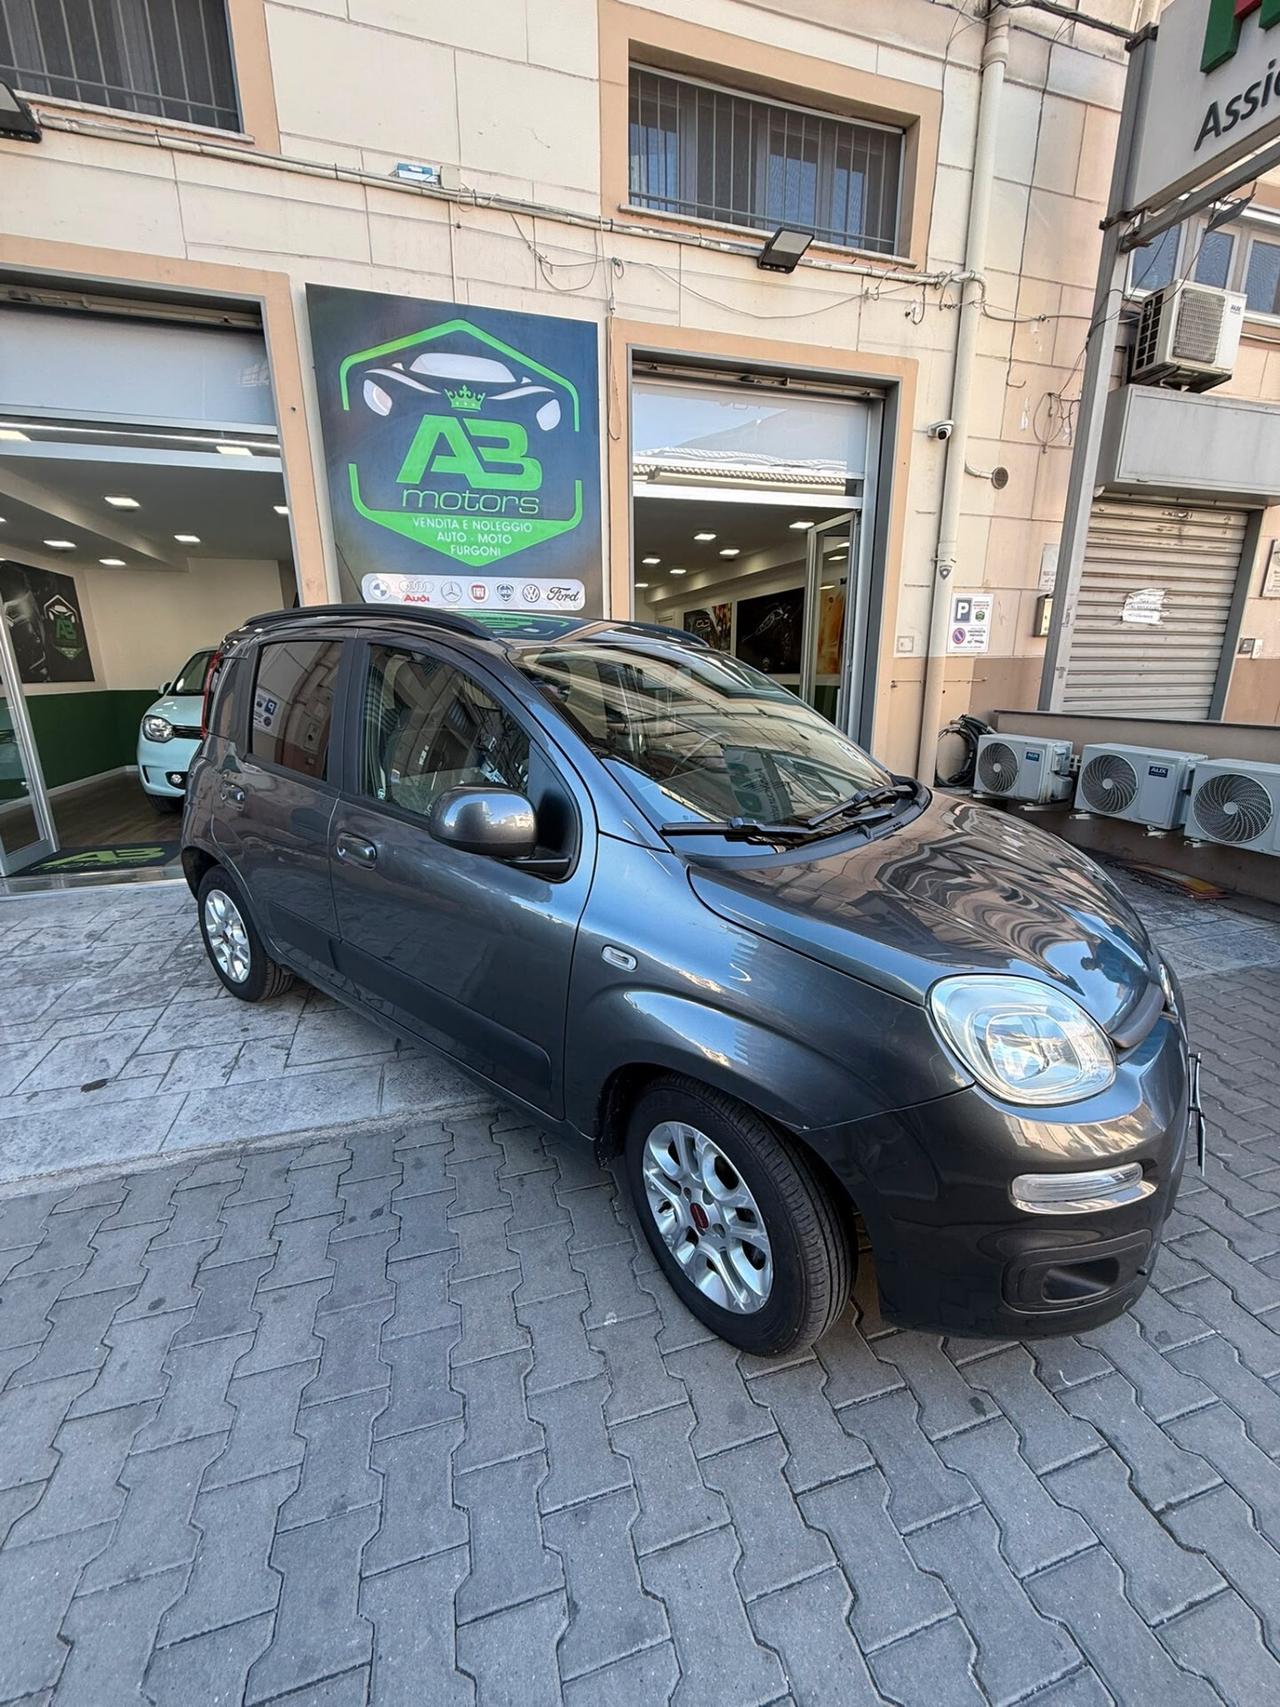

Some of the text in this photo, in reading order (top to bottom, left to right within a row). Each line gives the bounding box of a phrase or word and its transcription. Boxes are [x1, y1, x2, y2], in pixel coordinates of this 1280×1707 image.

[396, 414, 543, 492] AB
[402, 489, 539, 515] motors
[412, 517, 533, 532] VENDITA E NOLEGGIO
[436, 531, 467, 542] AUTO
[477, 533, 512, 544] MOTO
[450, 544, 501, 557] FURGONI
[403, 594, 430, 603] Audi
[546, 586, 579, 602] Ford
[956, 602, 970, 620] P
